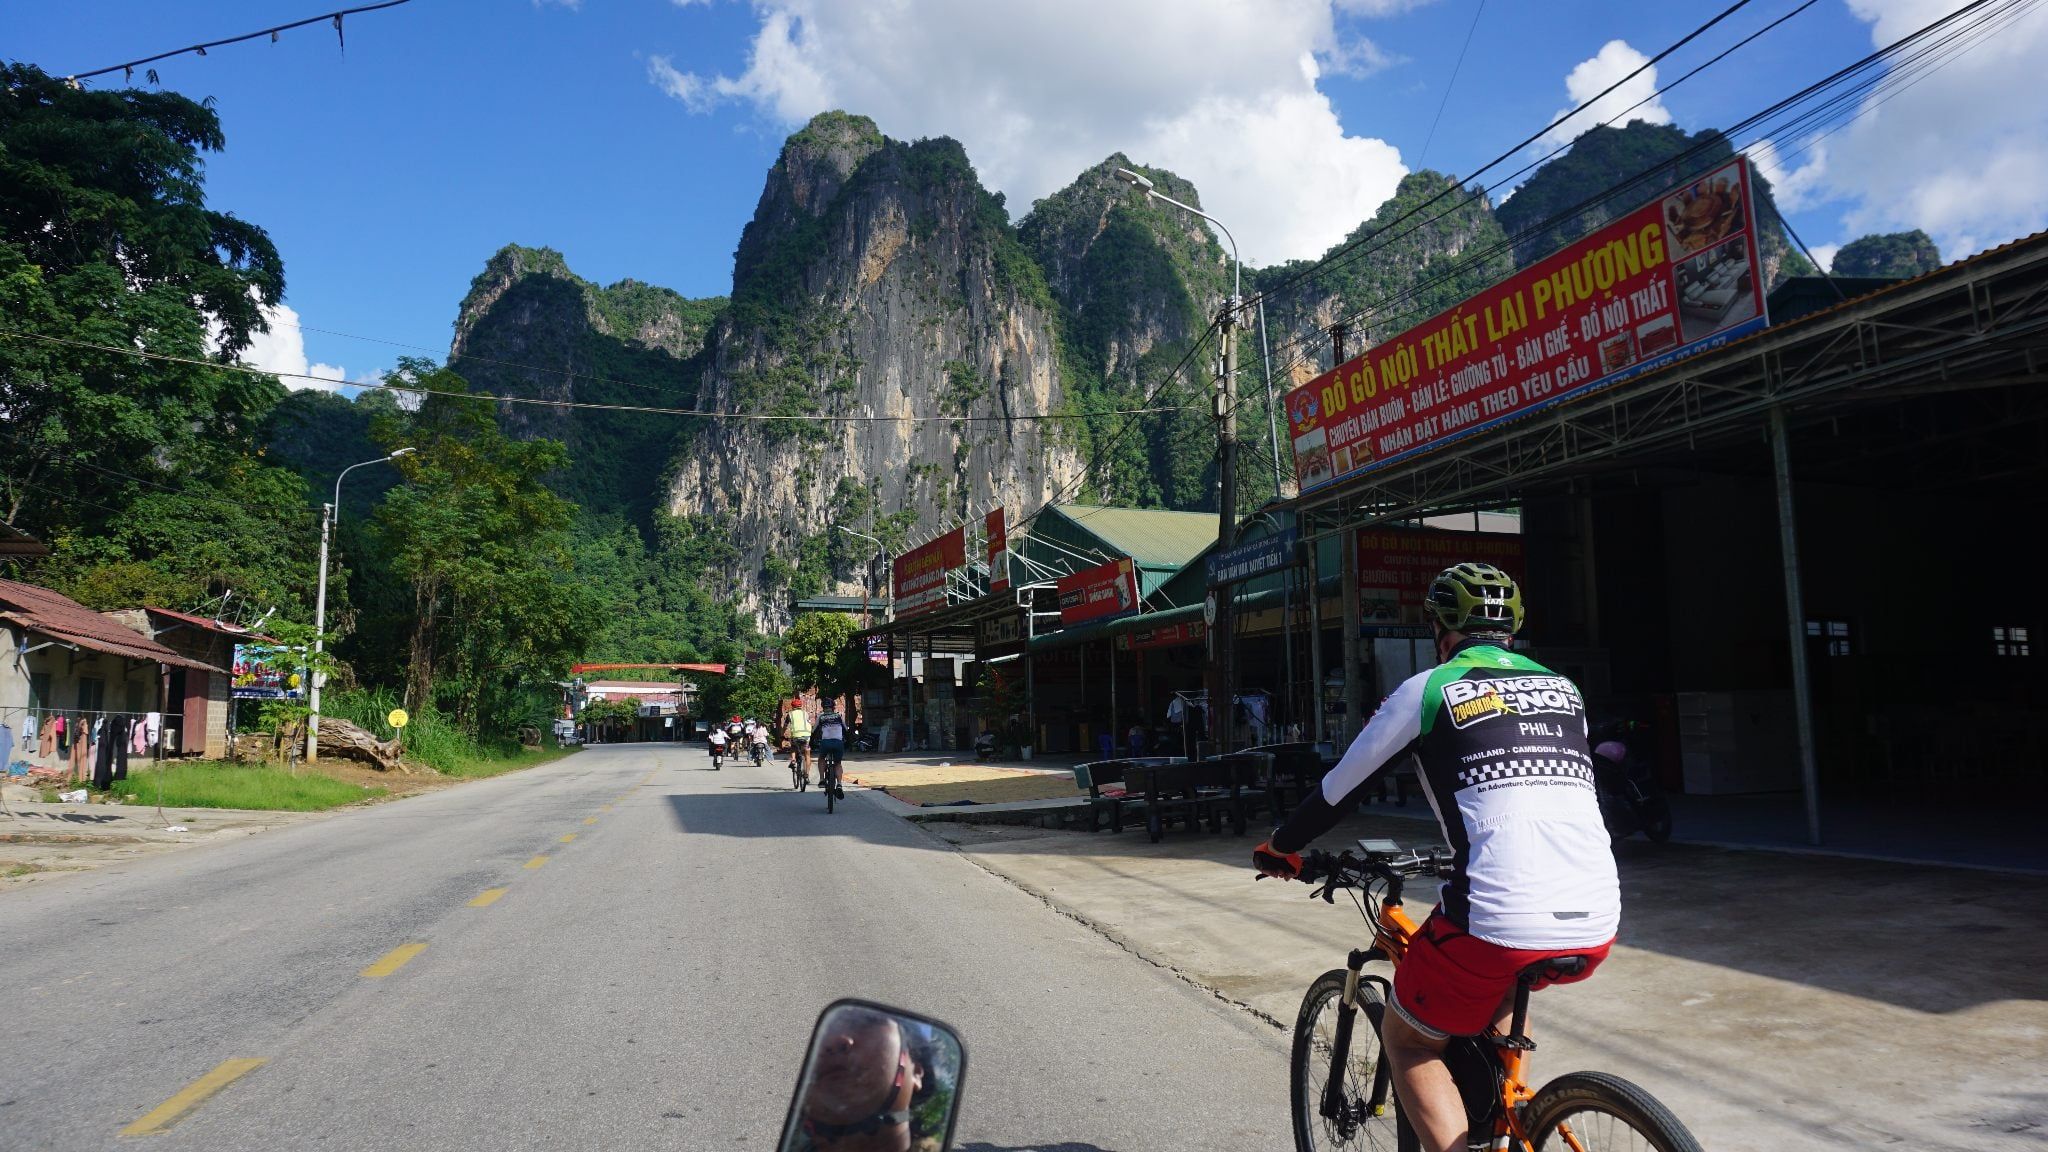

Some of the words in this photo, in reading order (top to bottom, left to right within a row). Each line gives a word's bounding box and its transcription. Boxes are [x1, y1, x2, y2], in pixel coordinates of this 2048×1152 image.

[1321, 370, 1347, 418] ĐỒ
[1351, 355, 1377, 404] GỖ
[1380, 342, 1419, 390] NỘI
[1421, 306, 1480, 371] THẤT
[1484, 290, 1529, 343] LAI
[1532, 223, 1665, 320] PHƯỢNG
[1329, 416, 1361, 447] CHUYÊN
[1361, 407, 1380, 434] BÁN
[1379, 396, 1406, 427] BUÔN
[1411, 384, 1434, 413] BÁN
[1450, 361, 1492, 397] GIƯỜNG
[1492, 343, 1508, 379] TỦ
[1516, 336, 1544, 370] BÀN
[1544, 314, 1571, 357] GHẾ
[1580, 302, 1601, 342] ĐỒ
[1602, 295, 1630, 333] NỘI
[1630, 273, 1668, 320] THẤT
[1380, 427, 1413, 455] NHẬN
[1414, 416, 1439, 442] ĐẶT
[1441, 401, 1480, 431] HÀNG
[1480, 386, 1519, 416] THEO
[1521, 371, 1552, 401] YÊU
[1555, 353, 1590, 388] CẦU
[1445, 678, 1575, 706] BANGERS
[1517, 691, 1570, 710] NOI
[1519, 722, 1554, 736] PHIL
[1555, 725, 1563, 737] J
[1461, 748, 1505, 764] THAILAND
[1512, 745, 1558, 754] CAMBODIA
[1562, 747, 1580, 758] LAOS
[1477, 786, 1487, 794] An
[1488, 780, 1523, 791] Adventure
[1524, 779, 1548, 788] Cycling
[1549, 779, 1578, 788] Company
